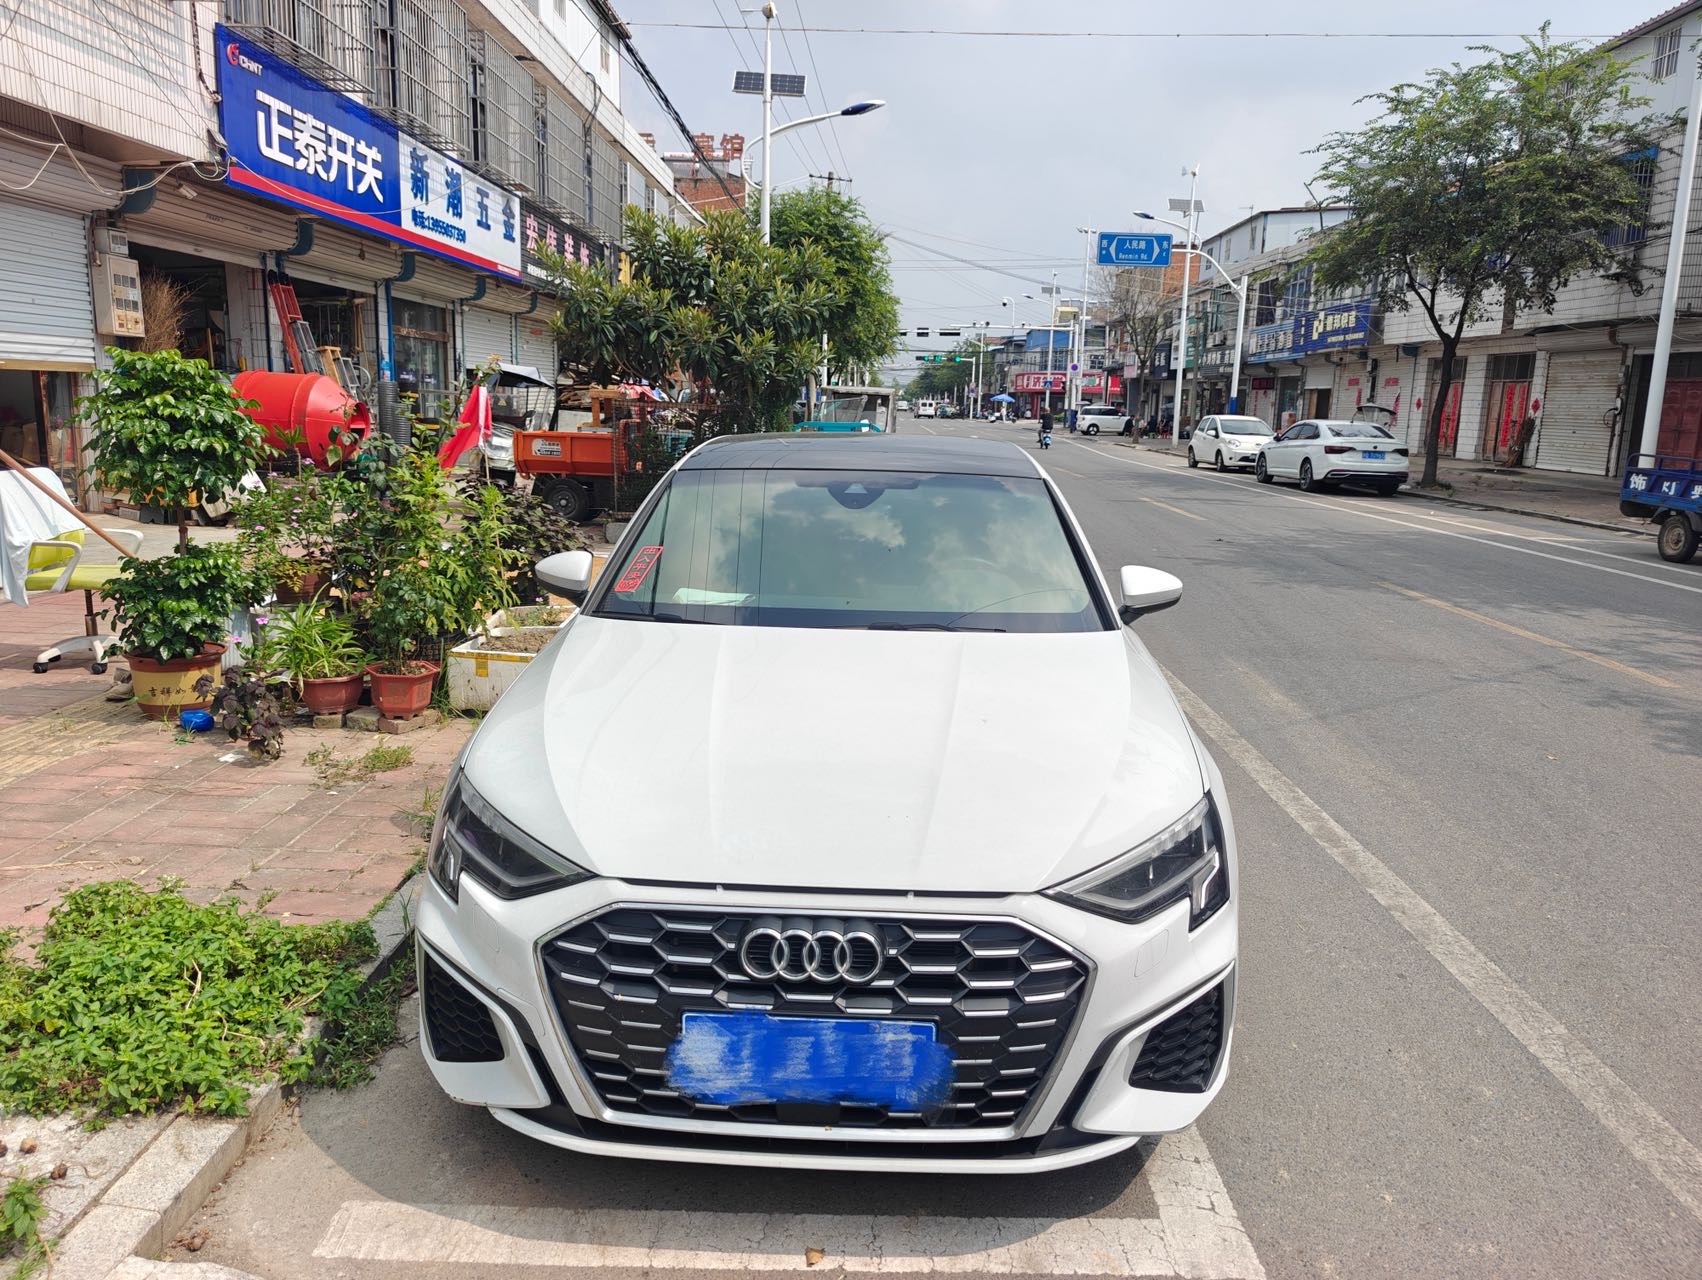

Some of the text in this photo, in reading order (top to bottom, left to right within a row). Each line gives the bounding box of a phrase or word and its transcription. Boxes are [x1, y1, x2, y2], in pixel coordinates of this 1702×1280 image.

[256, 90, 384, 204] 正泰开关
[1123, 239, 1146, 250] 人民路
[148, 686, 195, 697] 吉祥如
